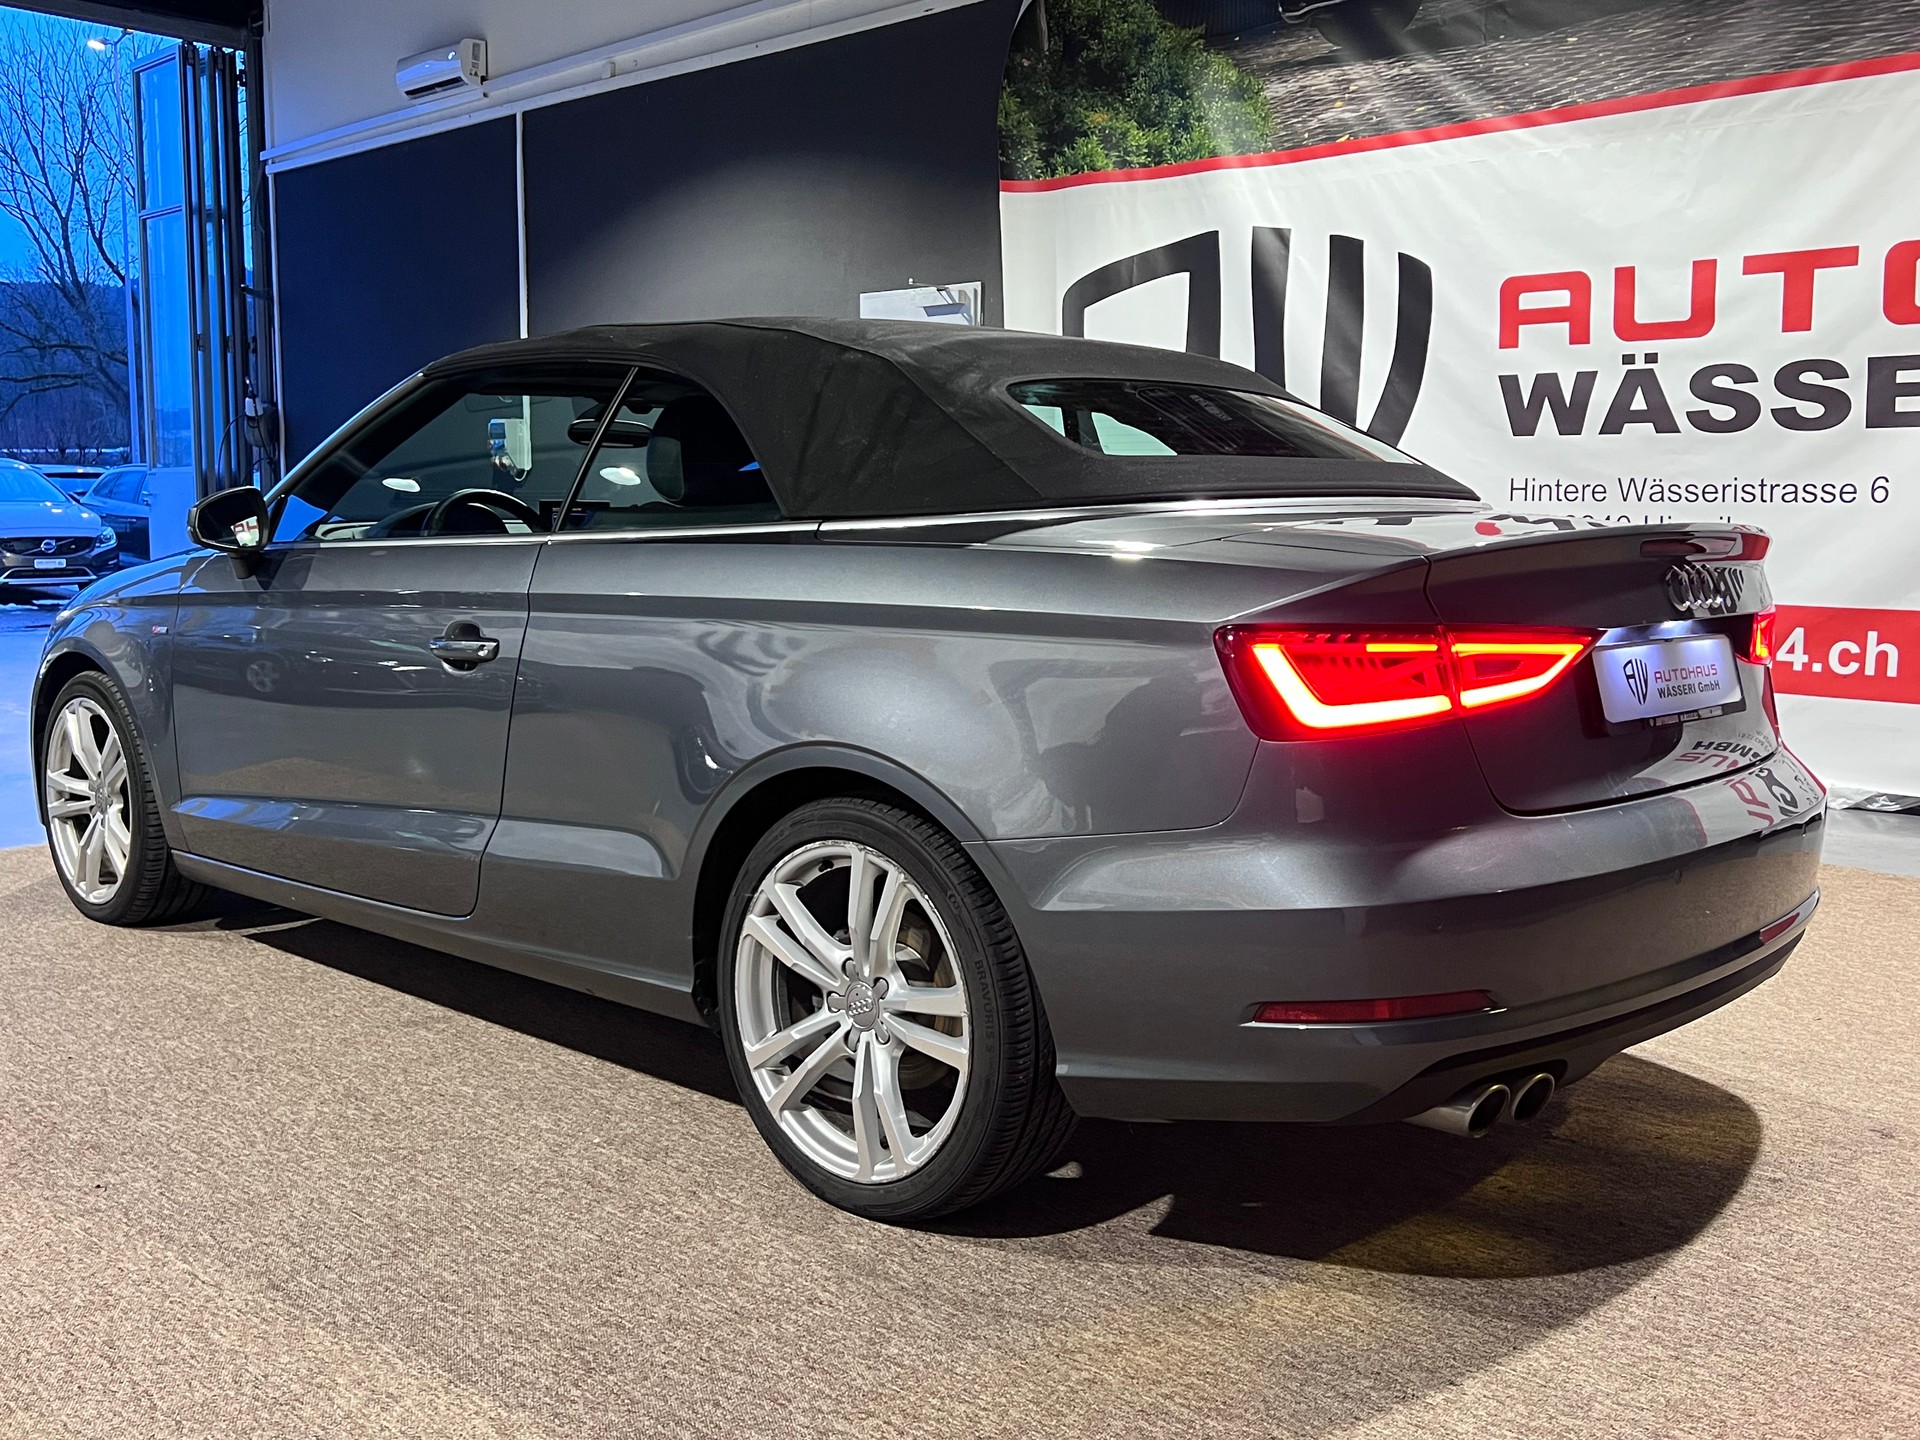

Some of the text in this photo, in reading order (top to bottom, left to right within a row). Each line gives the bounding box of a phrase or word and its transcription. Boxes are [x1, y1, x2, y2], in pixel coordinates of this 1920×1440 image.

[1498, 352, 1920, 436] WÄSSE
[1509, 475, 1890, 503] Hintere Wässeristrasse 6
[1654, 663, 1718, 684] AUTOHAUS
[1657, 679, 1721, 699] WÄSSERI GmbH
[974, 960, 995, 1039] BRAVURIS
